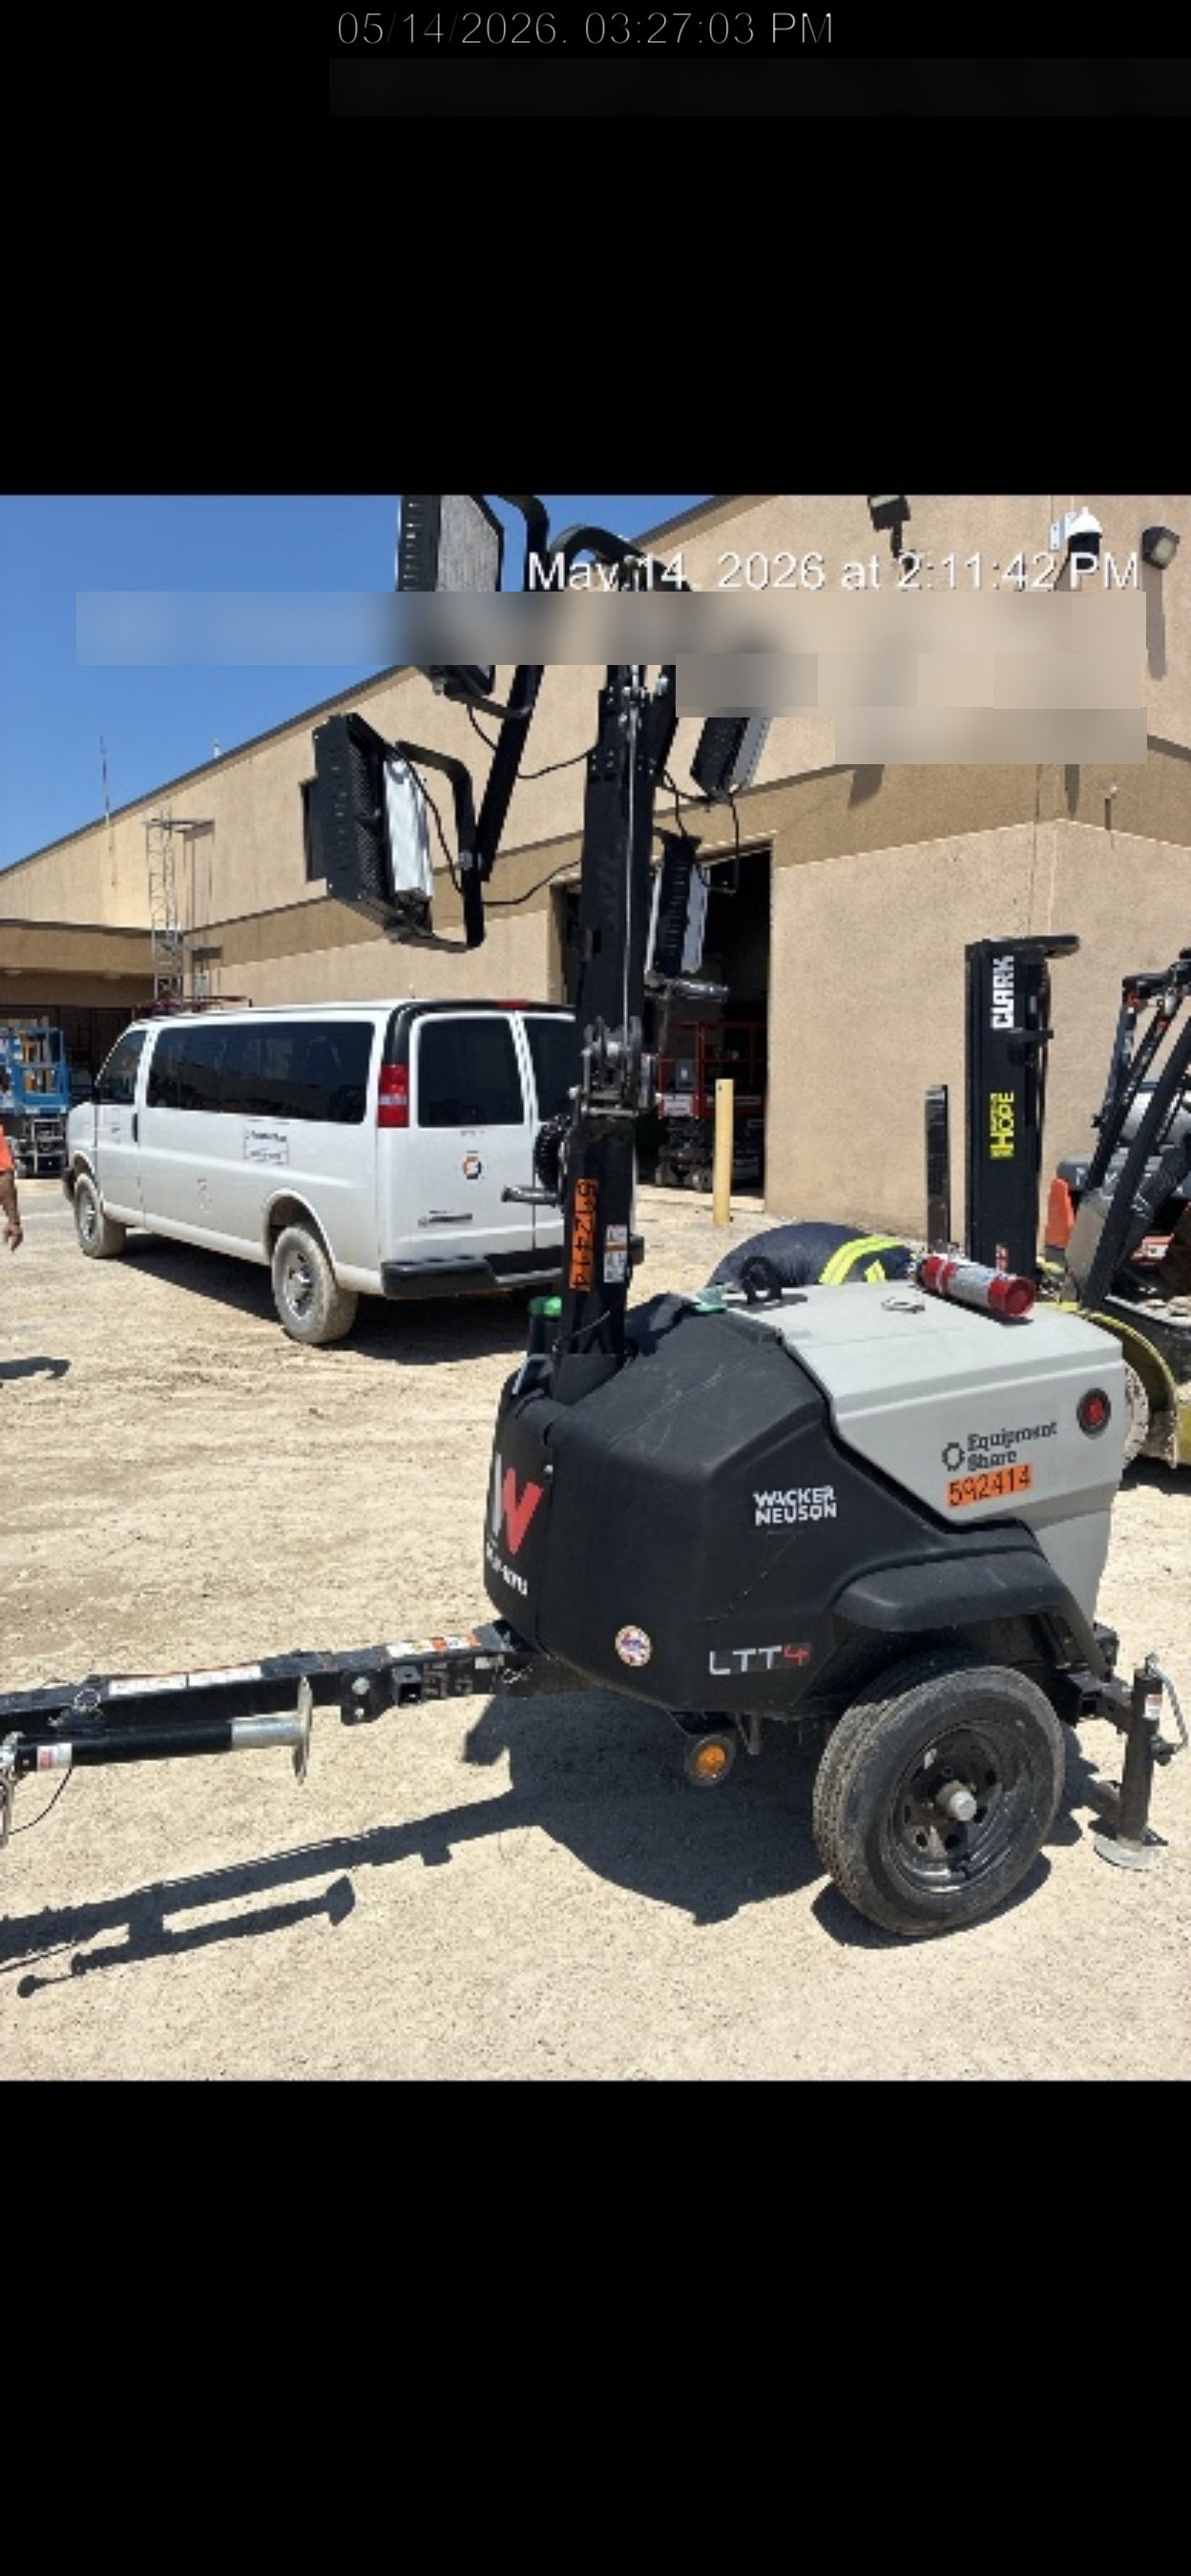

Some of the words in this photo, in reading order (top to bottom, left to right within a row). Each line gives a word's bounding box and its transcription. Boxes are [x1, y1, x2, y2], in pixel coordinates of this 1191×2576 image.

[991, 955, 1014, 1030] CLARK
[967, 1421, 1057, 1451] Equipment
[967, 1449, 1017, 1471] Share
[752, 1485, 836, 1508] WACKER
[948, 1465, 1031, 1506] 592414
[754, 1502, 837, 1527] NEUSON
[708, 1644, 810, 1676] LTT4
